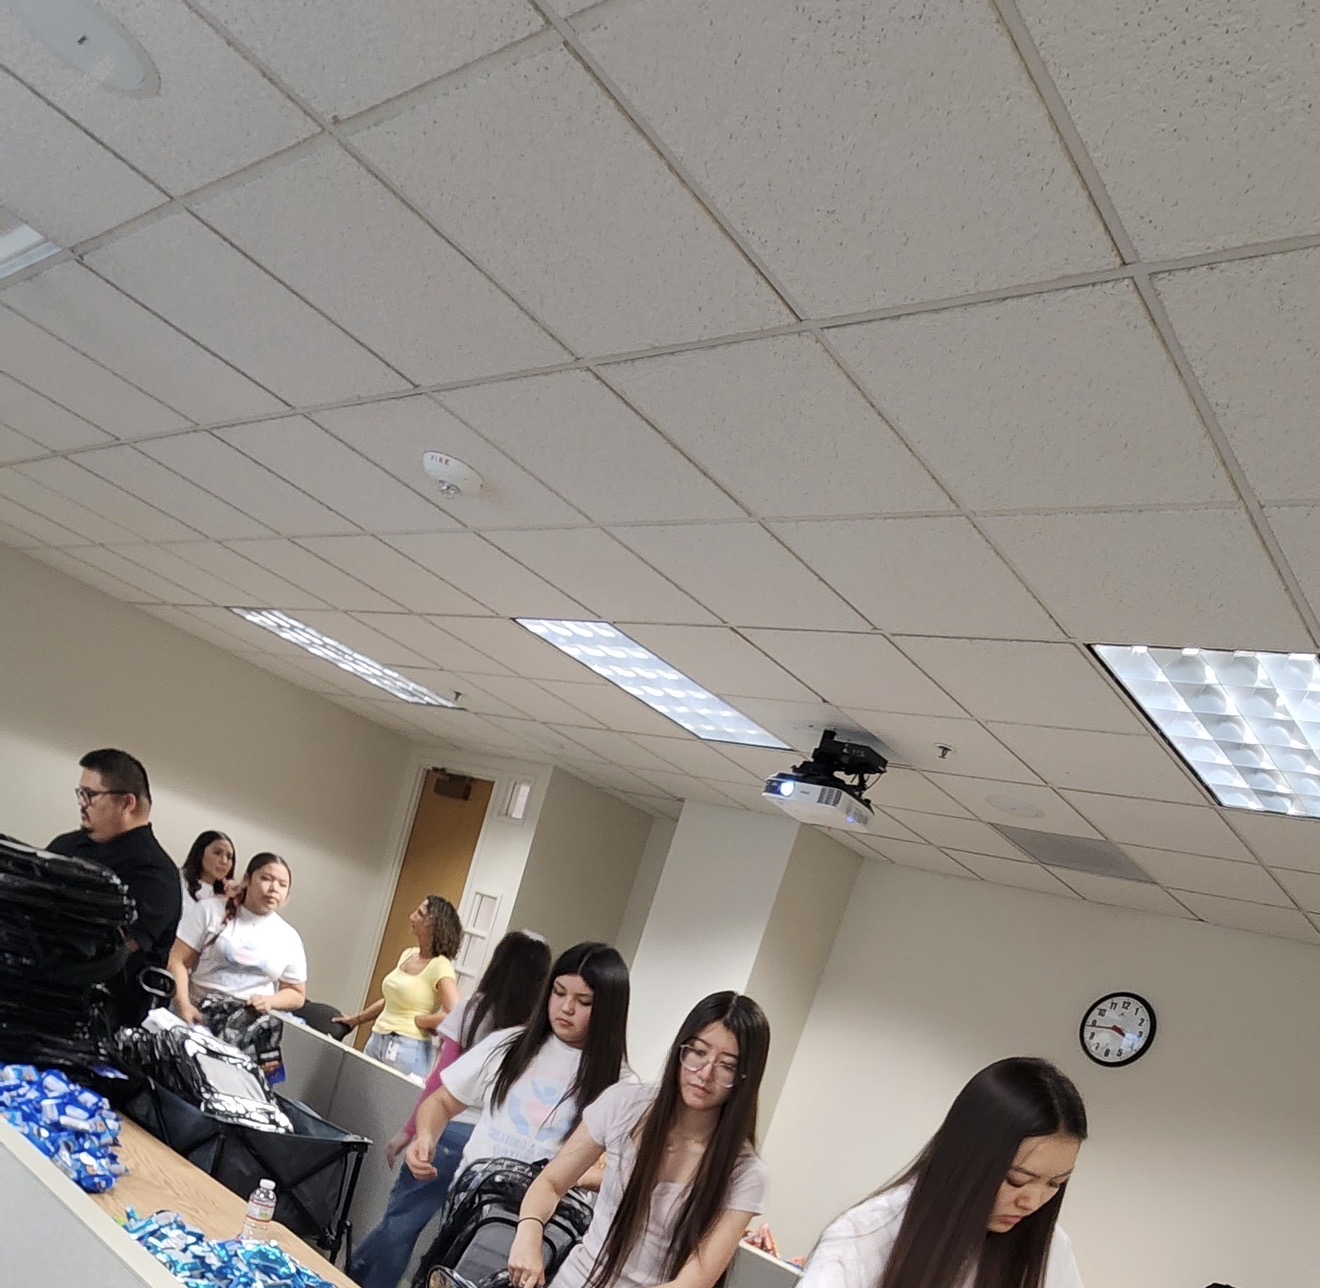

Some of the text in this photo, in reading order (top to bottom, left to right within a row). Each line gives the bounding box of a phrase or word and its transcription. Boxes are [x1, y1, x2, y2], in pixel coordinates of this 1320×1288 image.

[431, 455, 449, 466] FIRE
[1110, 1002, 1118, 1010] 11
[1122, 1001, 1131, 1010] 12
[1097, 1008, 1107, 1017] 10
[1134, 1008, 1139, 1016] 1
[1091, 1019, 1097, 1027] 9
[1138, 1018, 1145, 1026] 2
[1089, 1032, 1095, 1040] 8
[1104, 1048, 1110, 1057] 6
[1116, 1049, 1123, 1057] 5
